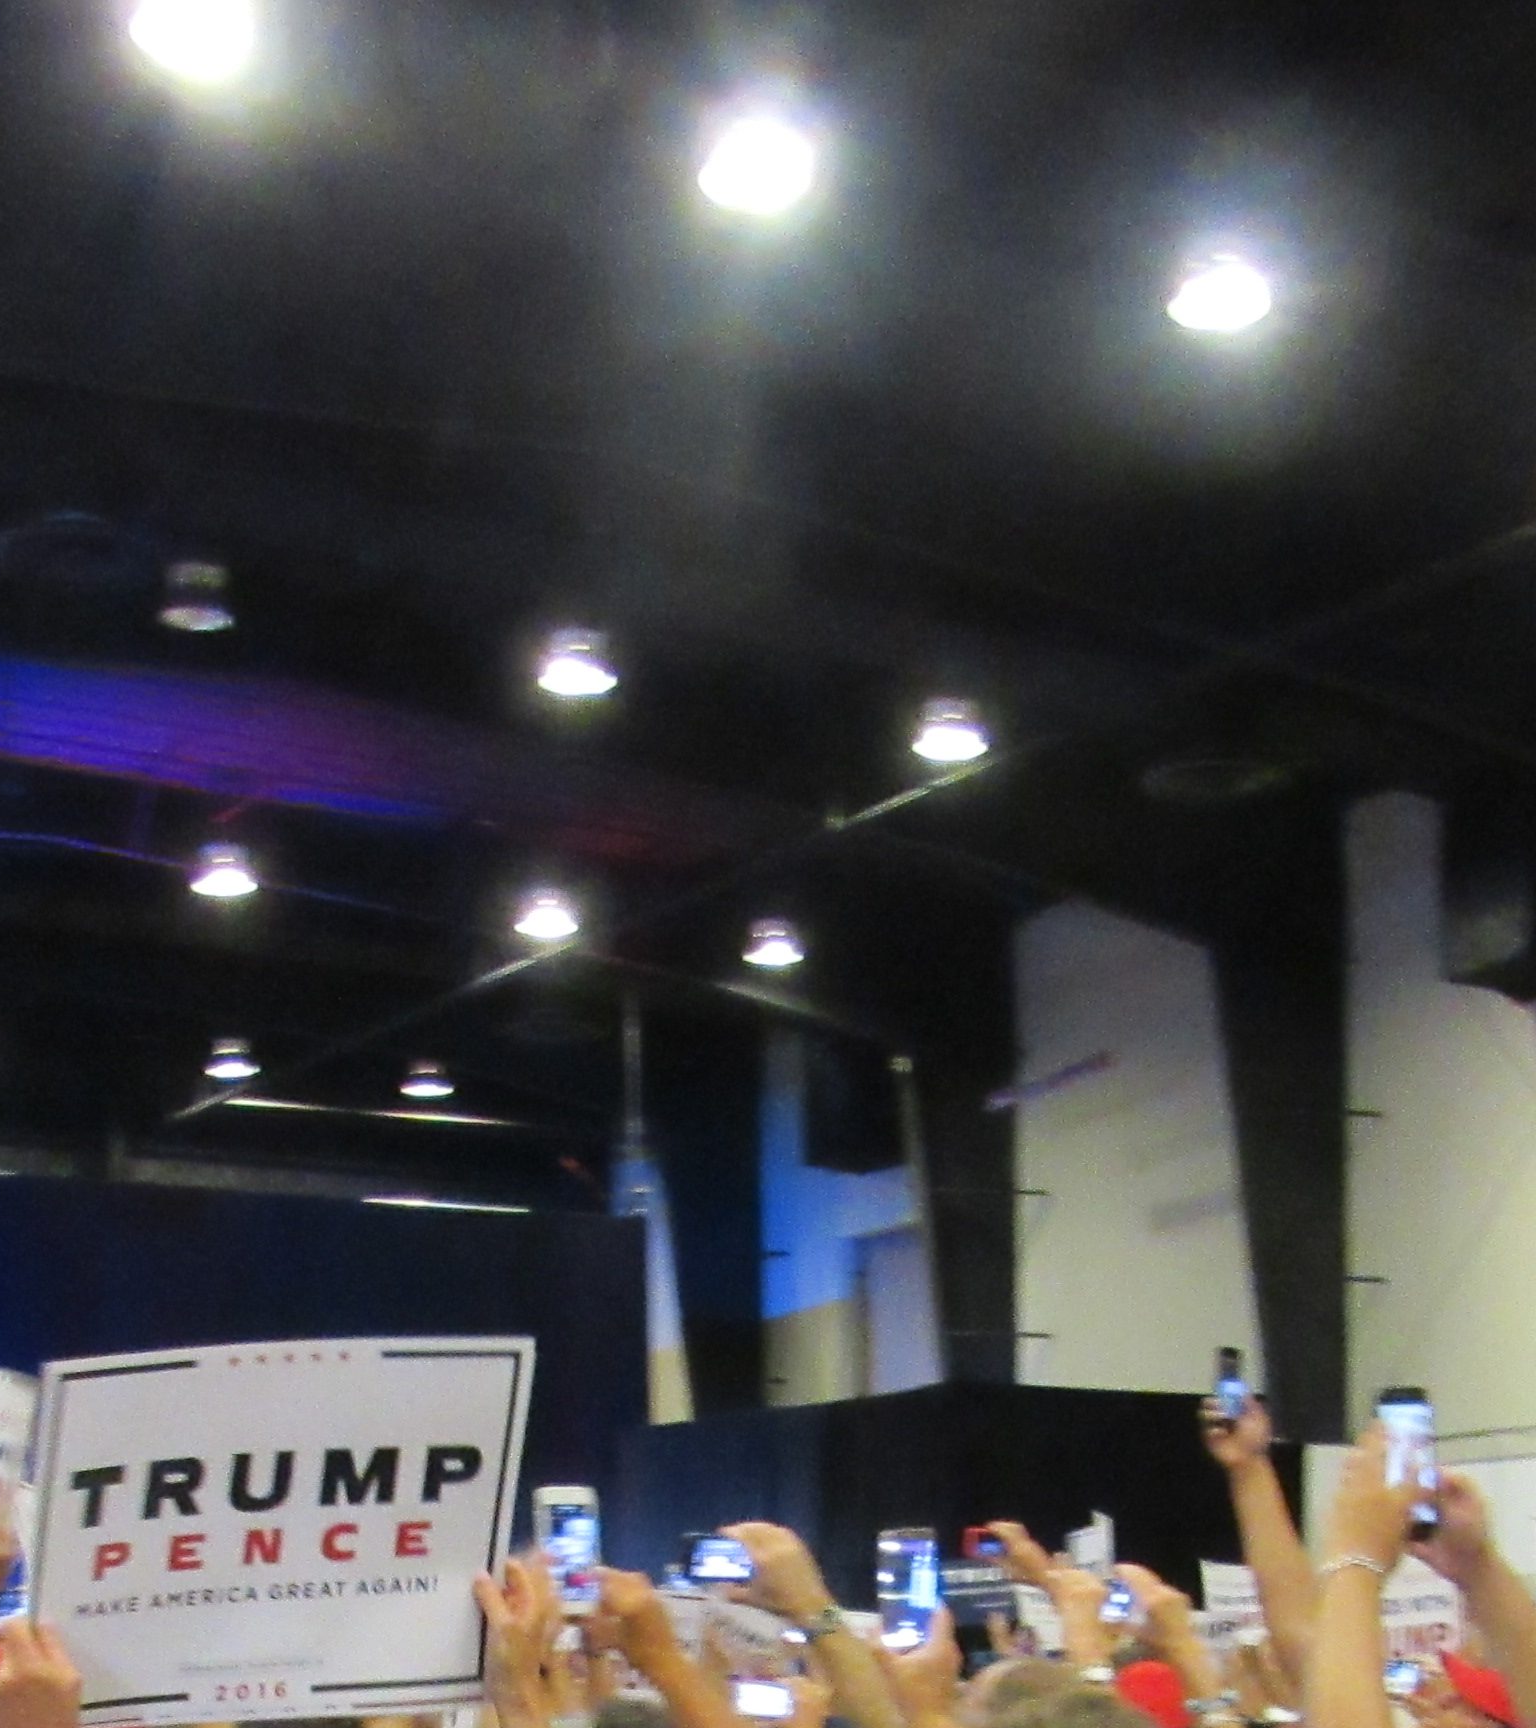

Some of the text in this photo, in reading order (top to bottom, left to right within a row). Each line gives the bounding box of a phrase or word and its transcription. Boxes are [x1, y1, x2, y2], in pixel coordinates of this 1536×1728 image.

[69, 1443, 484, 1529] TRUMP
[91, 1520, 434, 1582] PENCE
[75, 1574, 440, 1617] MAKE AMERICA GREAT AGAIN!
[215, 1681, 288, 1702] 2016
